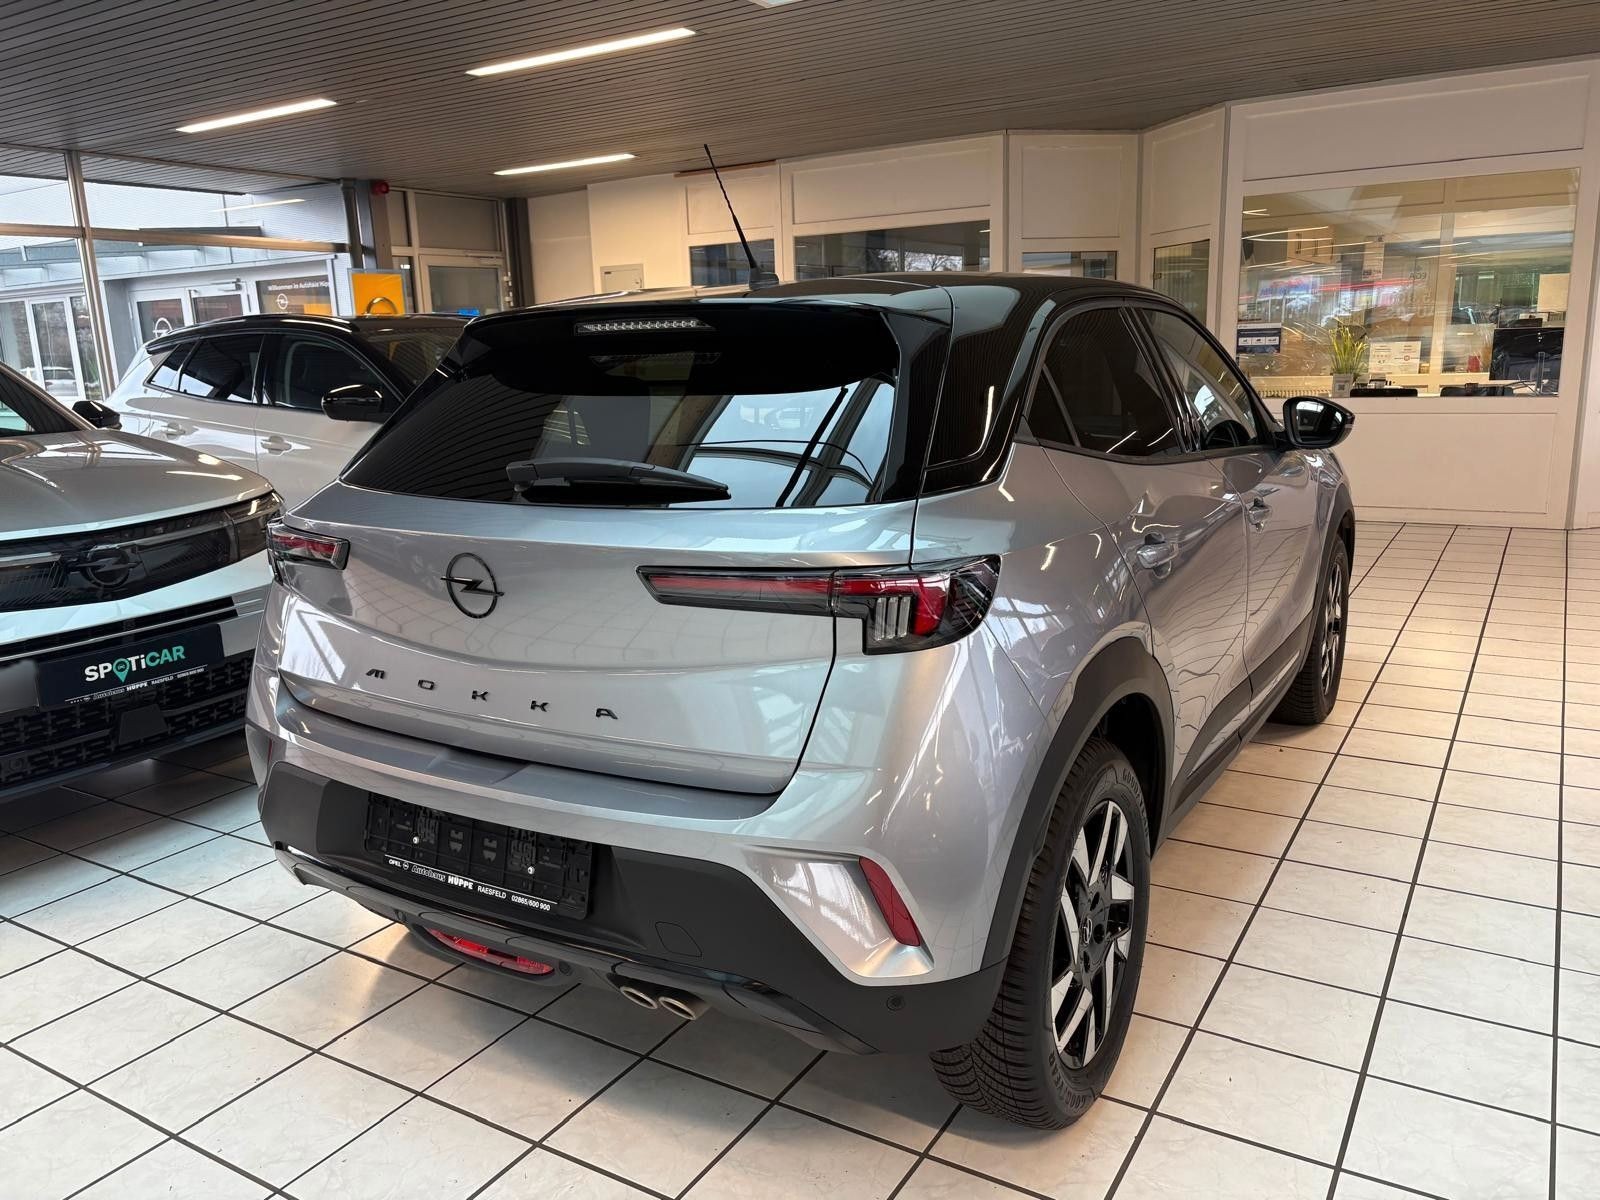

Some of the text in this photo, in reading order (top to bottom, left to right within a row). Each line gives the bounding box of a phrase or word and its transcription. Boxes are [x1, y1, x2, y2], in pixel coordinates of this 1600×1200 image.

[365, 667, 619, 720] MOKKA
[411, 864, 446, 882] Autohaus
[477, 885, 507, 899] RAESFELD
[539, 902, 551, 911] 900
